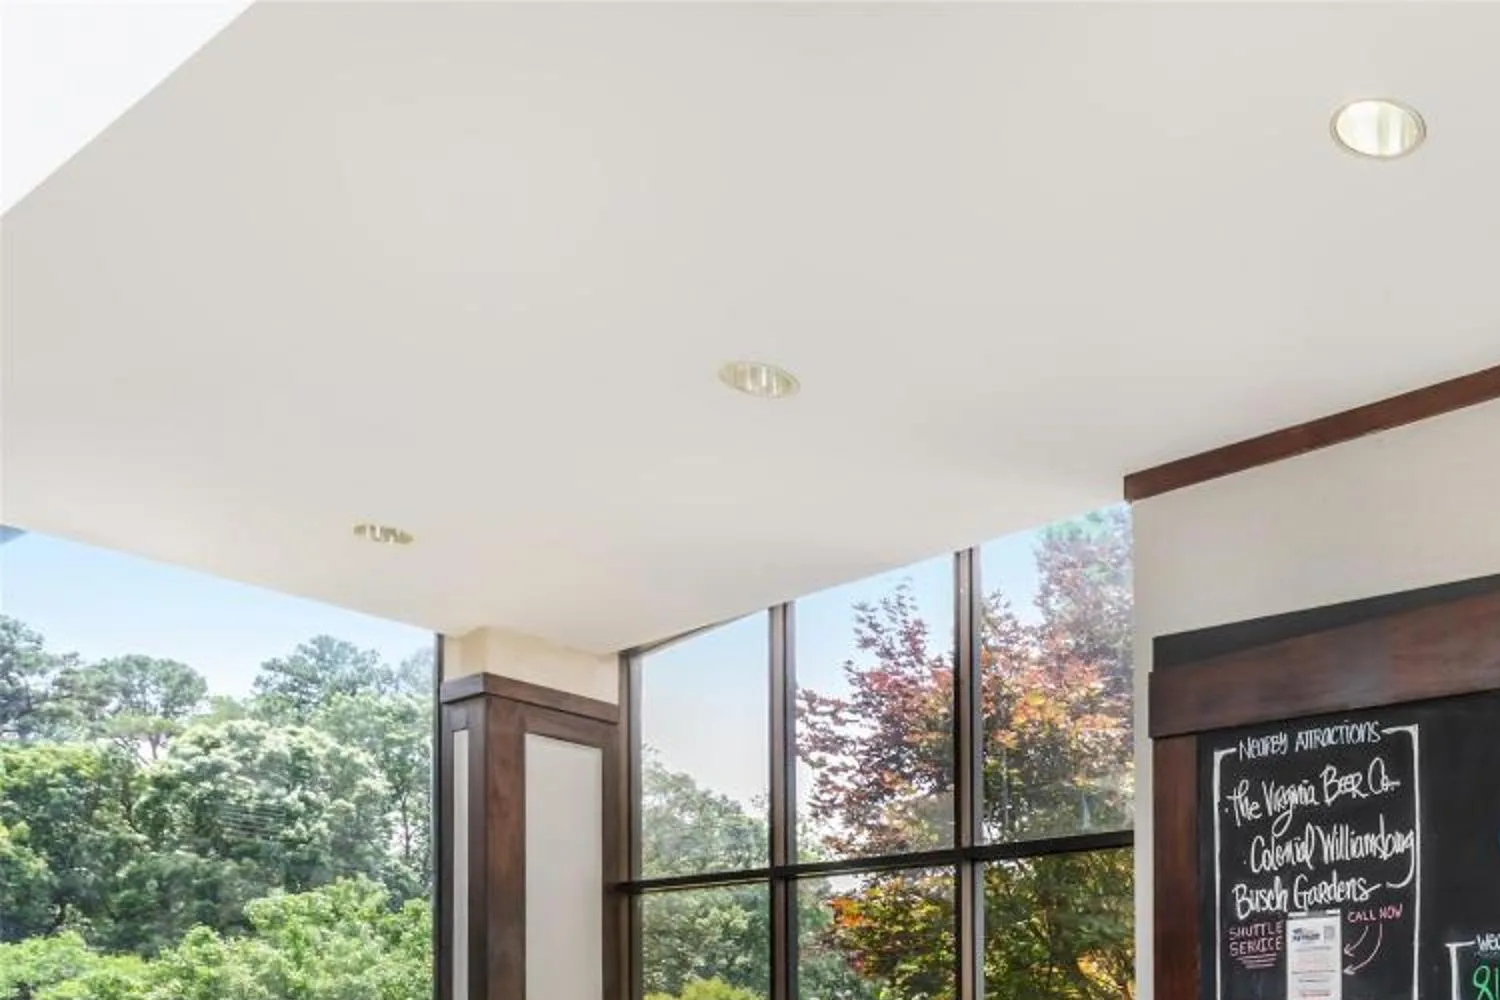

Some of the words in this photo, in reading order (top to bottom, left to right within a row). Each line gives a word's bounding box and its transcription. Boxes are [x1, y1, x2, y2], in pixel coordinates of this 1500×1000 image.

[1231, 875, 1289, 920] Busch
[1347, 910, 1377, 923] CALL
[1379, 903, 1403, 920] NOW
[1229, 920, 1284, 941] SHUTTLE
[1229, 938, 1284, 958] SERVICE
